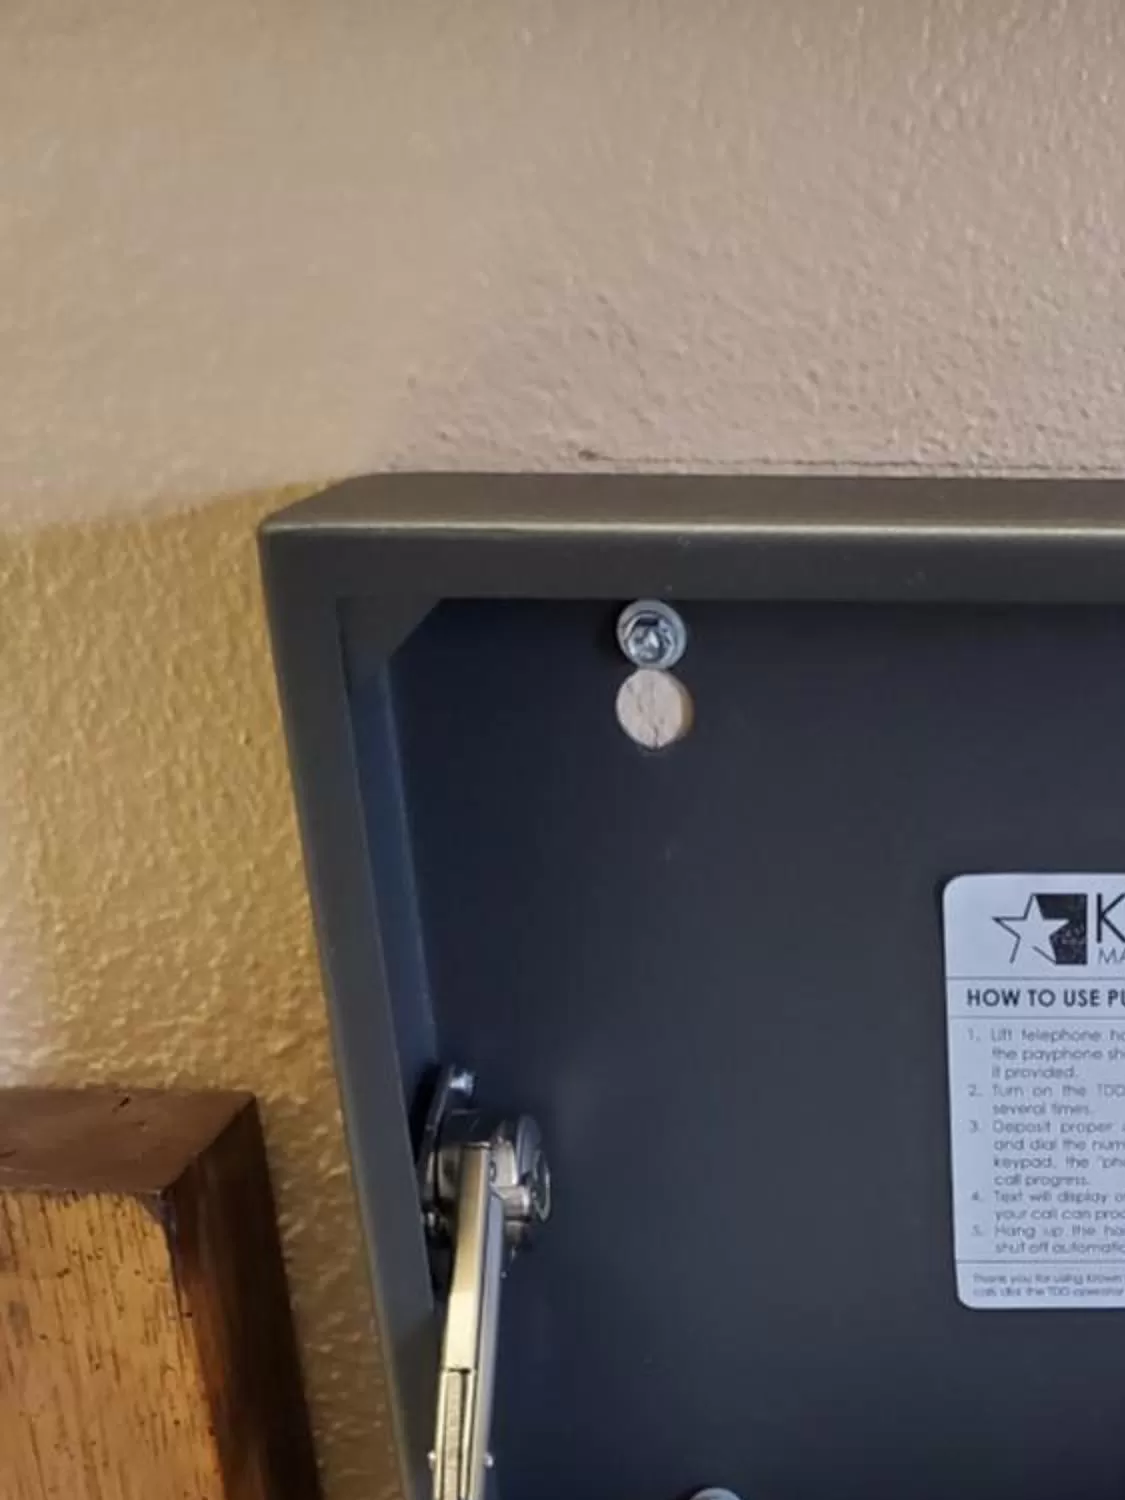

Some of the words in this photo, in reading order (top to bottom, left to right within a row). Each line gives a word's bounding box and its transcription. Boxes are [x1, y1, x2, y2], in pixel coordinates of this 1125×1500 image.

[967, 989, 1021, 1007] HOW
[1028, 989, 1056, 1007] TO
[1063, 989, 1099, 1007] USE
[990, 1029, 1013, 1043] Lift
[1021, 1029, 1099, 1046] telephone
[991, 1047, 1017, 1059] the
[1022, 1047, 1102, 1064] payphone
[992, 1084, 1024, 1097] Turn
[1031, 1087, 1053, 1097] on
[1062, 1084, 1086, 1097] the
[992, 1104, 1046, 1115] several
[993, 1120, 1051, 1135] Deposit
[1059, 1122, 1113, 1136] proper
[994, 1138, 1024, 1151] and
[1029, 1138, 1056, 1151] dial
[1063, 1138, 1086, 1151] the
[1066, 1156, 1089, 1168] the
[994, 1174, 1021, 1185] call
[994, 1191, 1023, 1202] Text
[1028, 1191, 1053, 1202] will
[1057, 1191, 1107, 1205] display
[995, 1209, 1027, 1222] your
[1030, 1207, 1057, 1219] call
[1061, 1209, 1091, 1219] can
[995, 1224, 1035, 1240] Hang
[1043, 1226, 1063, 1239] up
[1072, 1224, 1094, 1236] the
[995, 1241, 1025, 1253] shut
[1027, 1241, 1049, 1253] off
